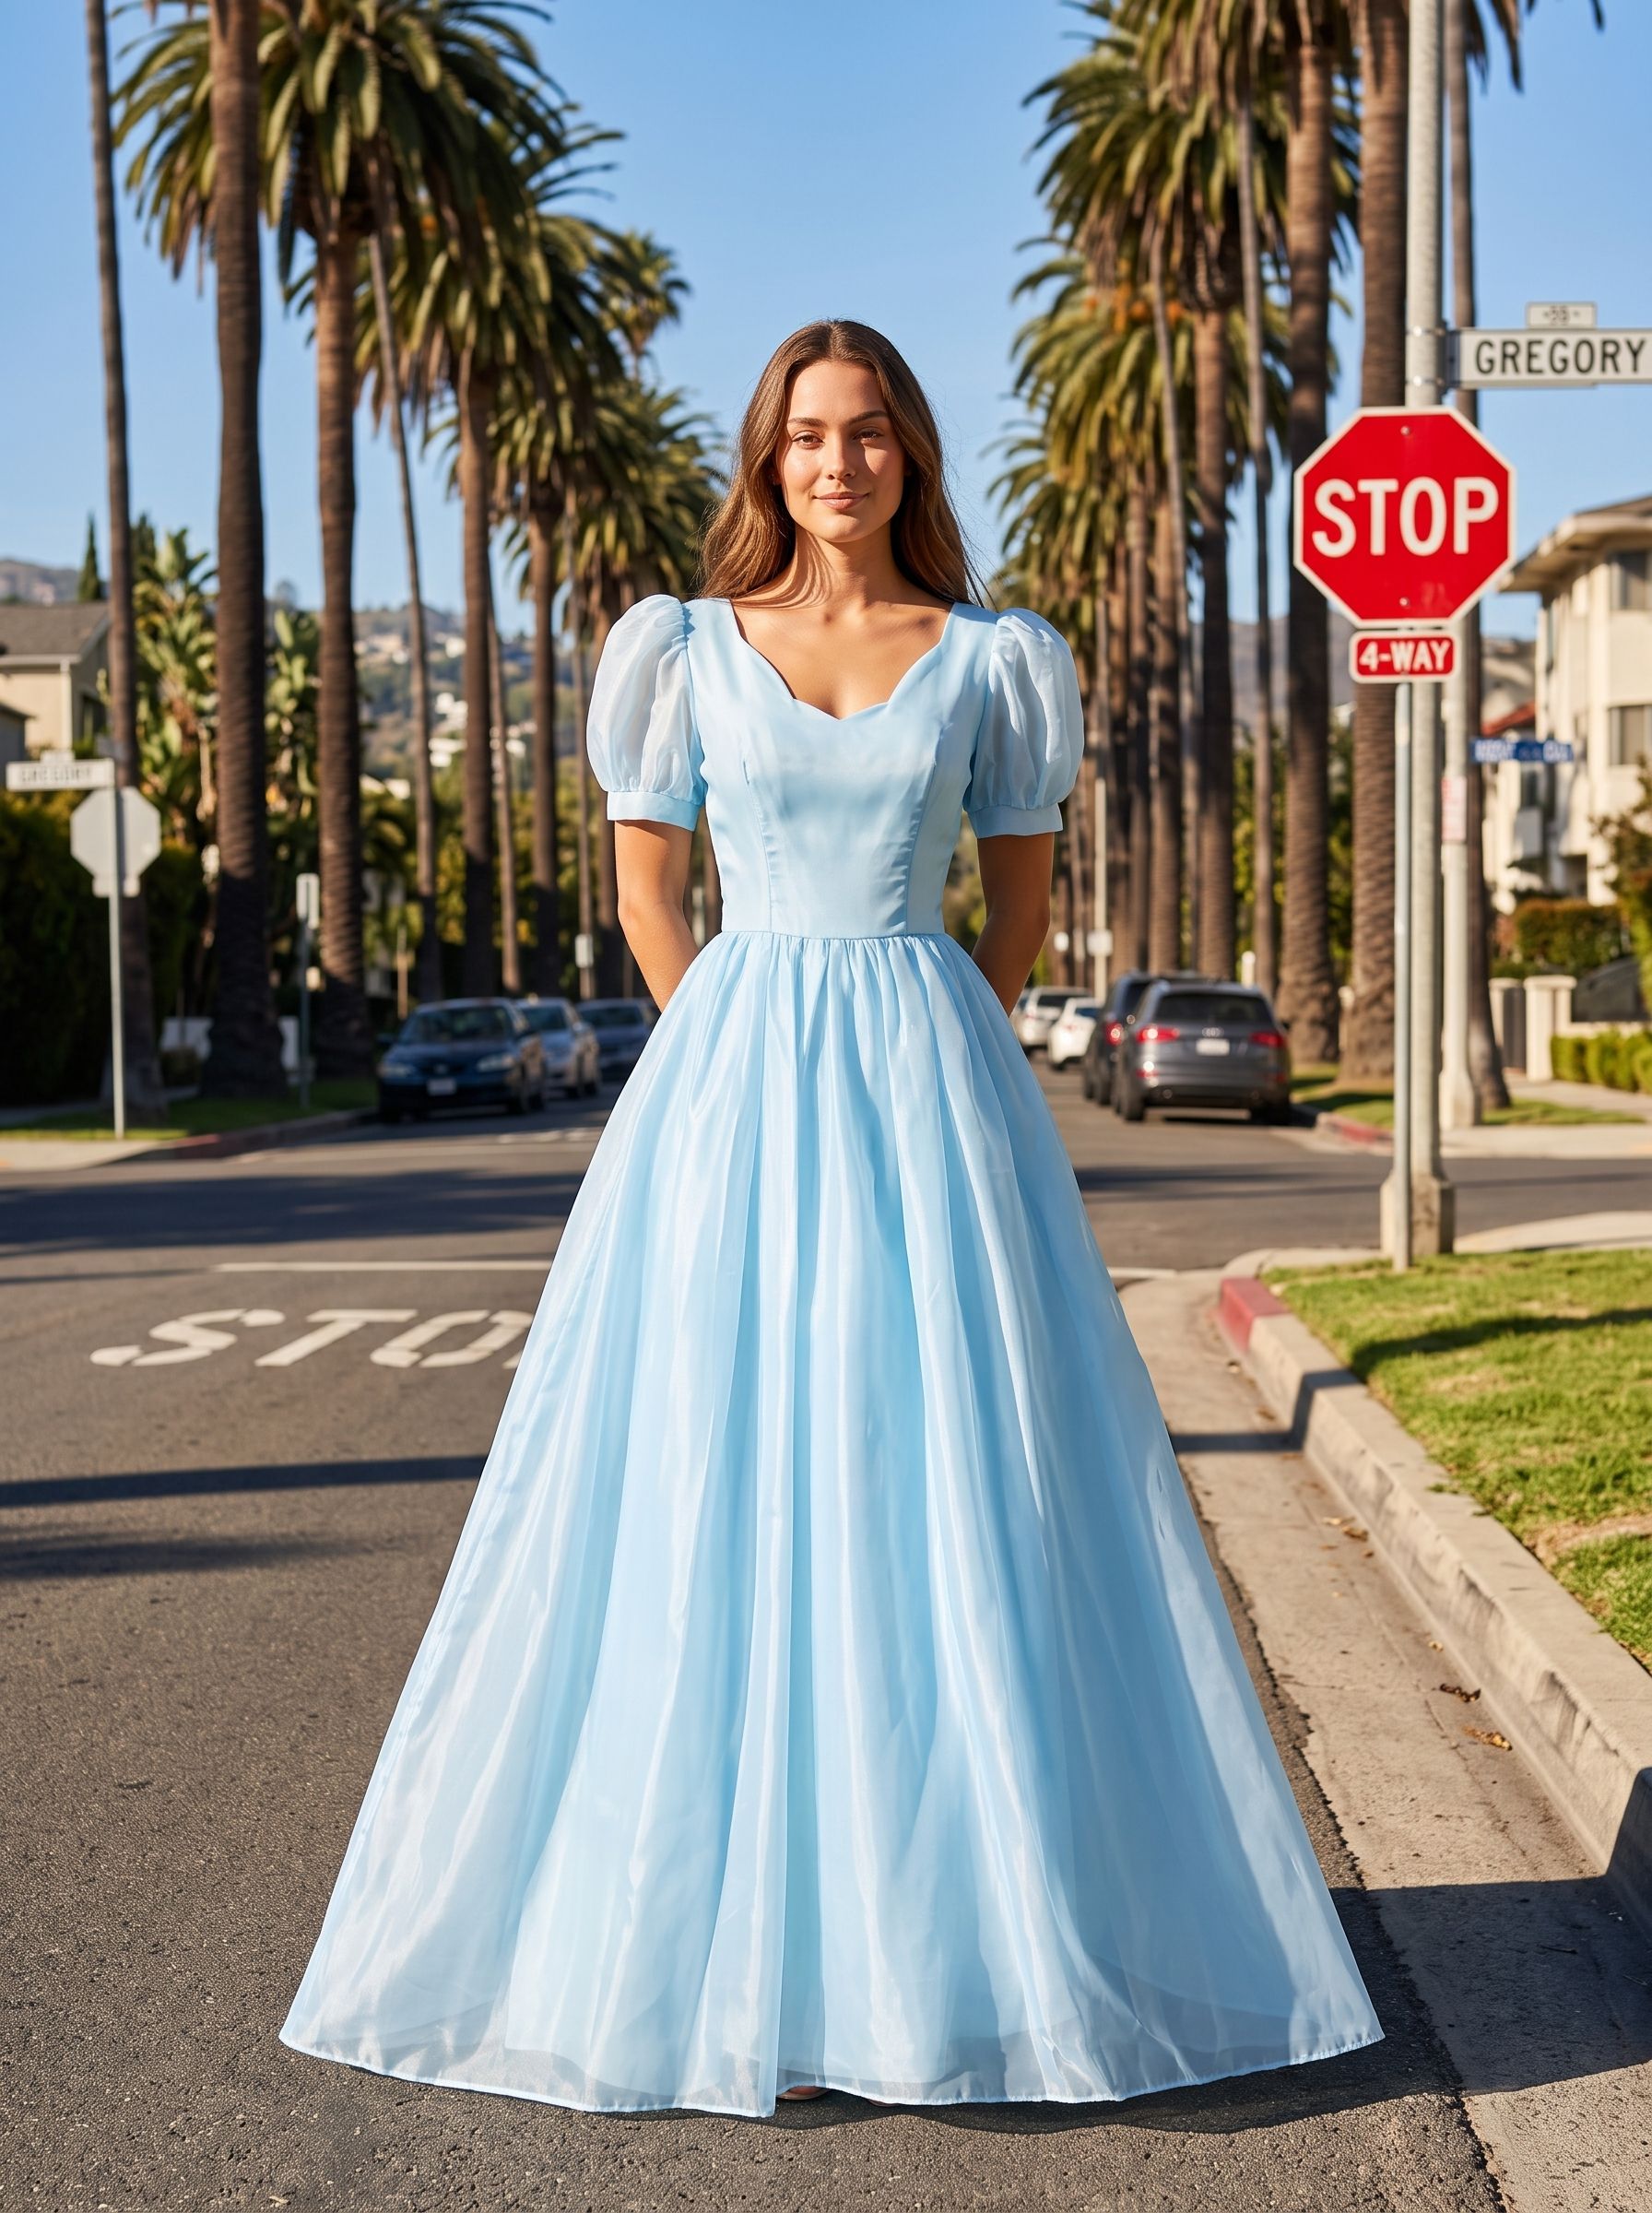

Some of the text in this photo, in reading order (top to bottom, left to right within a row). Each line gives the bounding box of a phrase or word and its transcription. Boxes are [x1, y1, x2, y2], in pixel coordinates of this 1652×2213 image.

[1476, 339, 1646, 374] GREGORY
[1312, 477, 1499, 558] STOP
[1359, 639, 1451, 672] 4-WAY
[89, 1308, 534, 1369] STO
